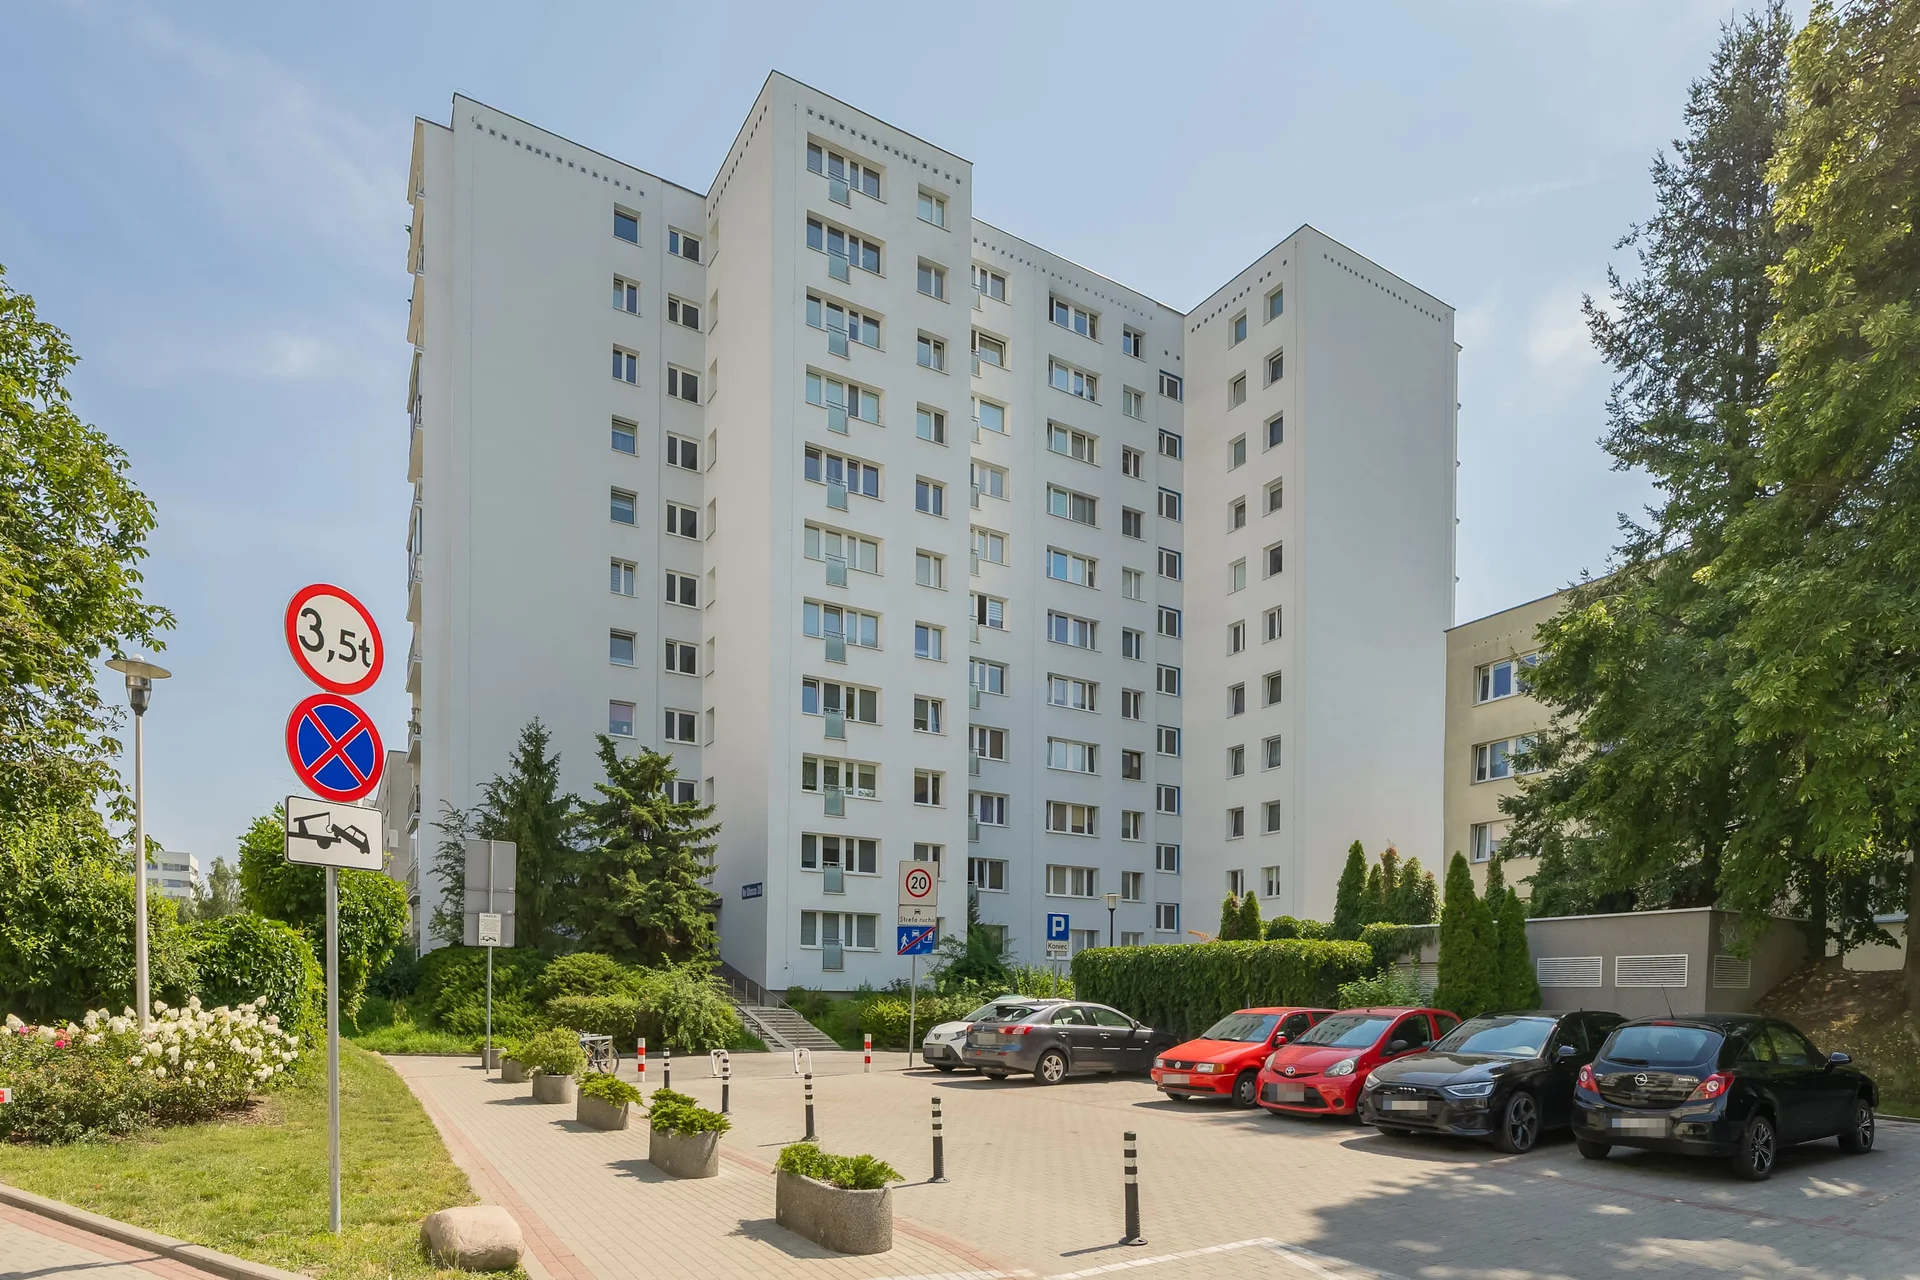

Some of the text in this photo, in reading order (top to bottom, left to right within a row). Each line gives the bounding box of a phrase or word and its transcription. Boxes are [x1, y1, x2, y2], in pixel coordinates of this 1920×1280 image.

[299, 607, 371, 668] 3,5t
[911, 876, 927, 890] 20
[1052, 916, 1065, 937] P
